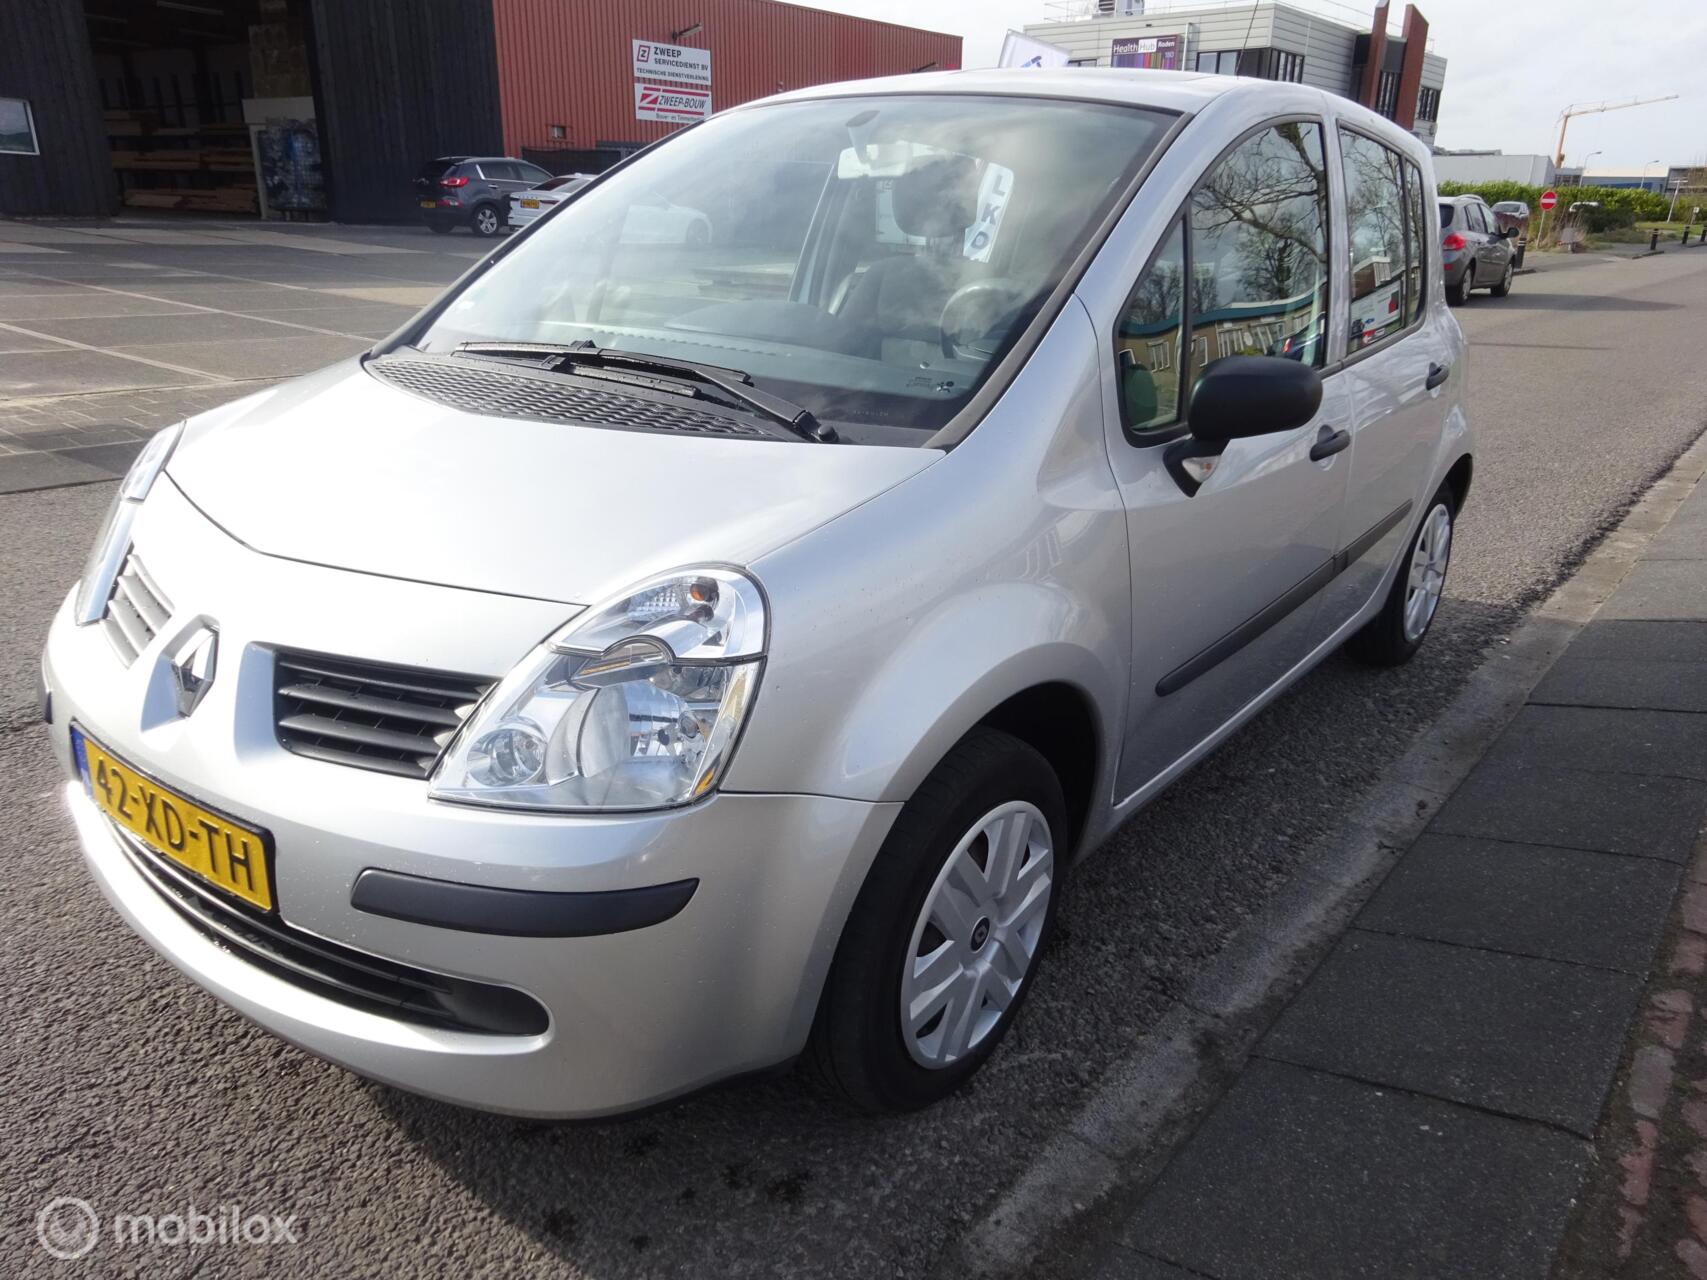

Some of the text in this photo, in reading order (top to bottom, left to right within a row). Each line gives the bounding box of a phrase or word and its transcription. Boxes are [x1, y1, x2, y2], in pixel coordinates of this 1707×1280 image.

[653, 46, 682, 58] ZWEEP
[1113, 43, 1138, 53] Health
[1140, 41, 1156, 51] Hub
[654, 58, 700, 69] SERVICEDIENST
[637, 67, 667, 77] TECHNISCHE
[659, 95, 706, 110] ZWEEP-BOUW
[96, 756, 255, 892] 42-XD-TH
